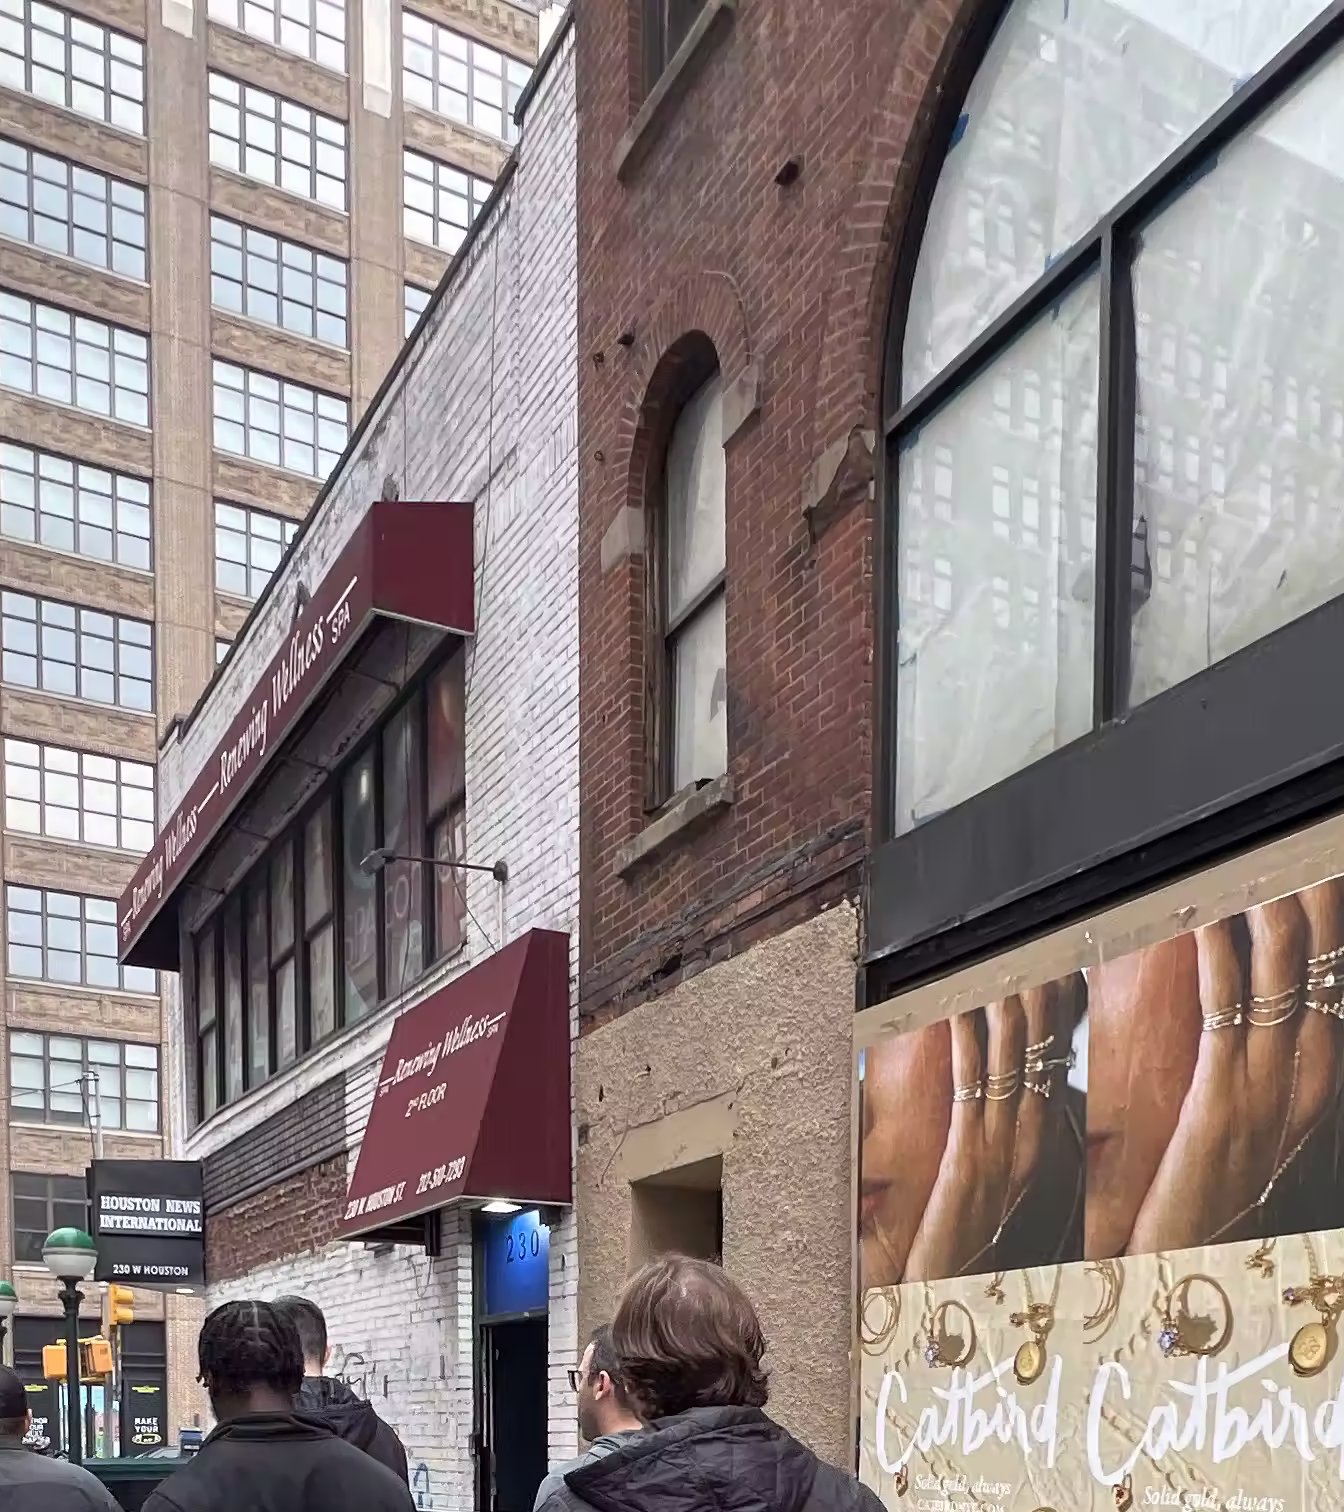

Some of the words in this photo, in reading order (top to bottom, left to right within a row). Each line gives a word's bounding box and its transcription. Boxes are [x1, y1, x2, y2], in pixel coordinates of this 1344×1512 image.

[331, 601, 351, 643] SPA
[219, 699, 268, 794] Renewing
[272, 615, 324, 716] Wellness
[392, 1041, 442, 1085] Renewing
[441, 1014, 490, 1059] Wellness
[417, 1083, 447, 1111] FLOOR
[100, 1195, 160, 1212] HOUSTON
[165, 1199, 201, 1214] NEWS
[99, 1214, 202, 1232] INTERNATIONAL
[505, 1229, 540, 1264] 230
[112, 1264, 130, 1275] 230
[132, 1265, 142, 1275] W
[143, 1265, 189, 1276] HOUSTON
[875, 1353, 1063, 1475] Catbird
[134, 1425, 159, 1433] YOUR
[972, 1475, 1012, 1496] always
[1143, 1485, 1180, 1505] Solid
[1180, 1488, 1222, 1512] gold,
